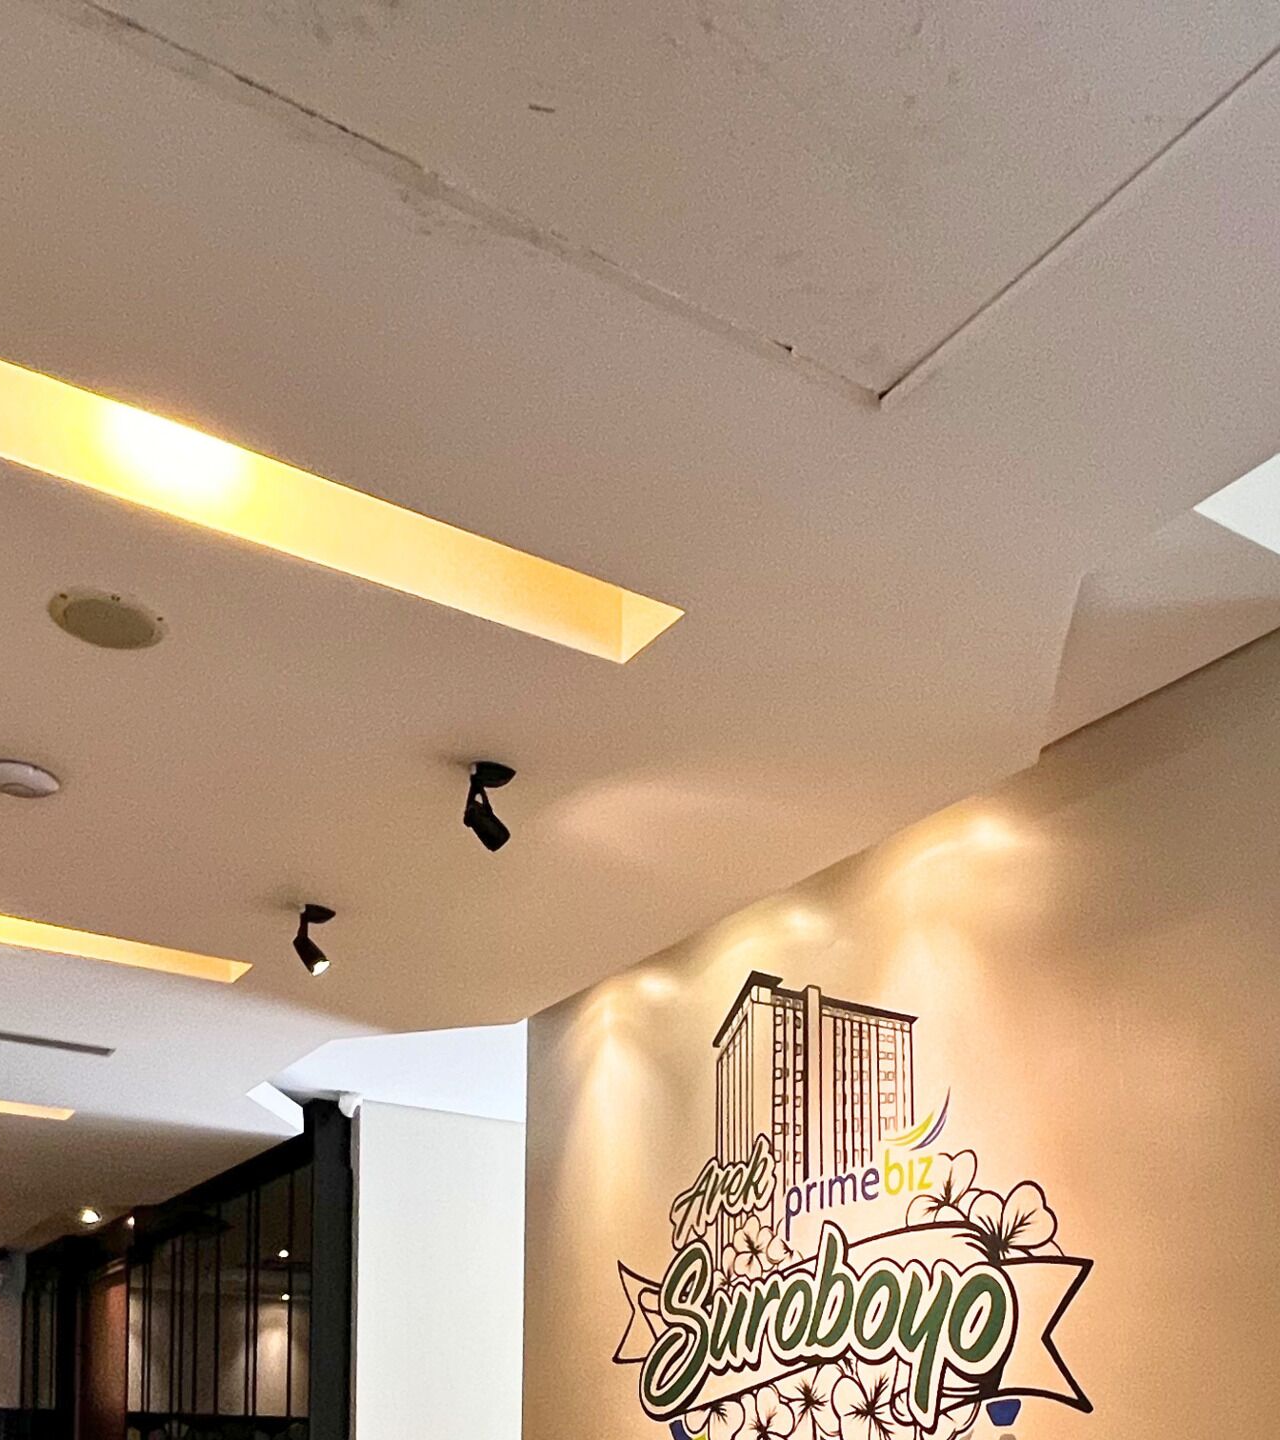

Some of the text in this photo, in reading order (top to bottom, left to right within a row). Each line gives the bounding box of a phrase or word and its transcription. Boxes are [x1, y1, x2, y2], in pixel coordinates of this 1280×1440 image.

[673, 1138, 771, 1242] Arek
[785, 1148, 935, 1242] primebiz
[643, 1231, 1007, 1414] Suroboyo
